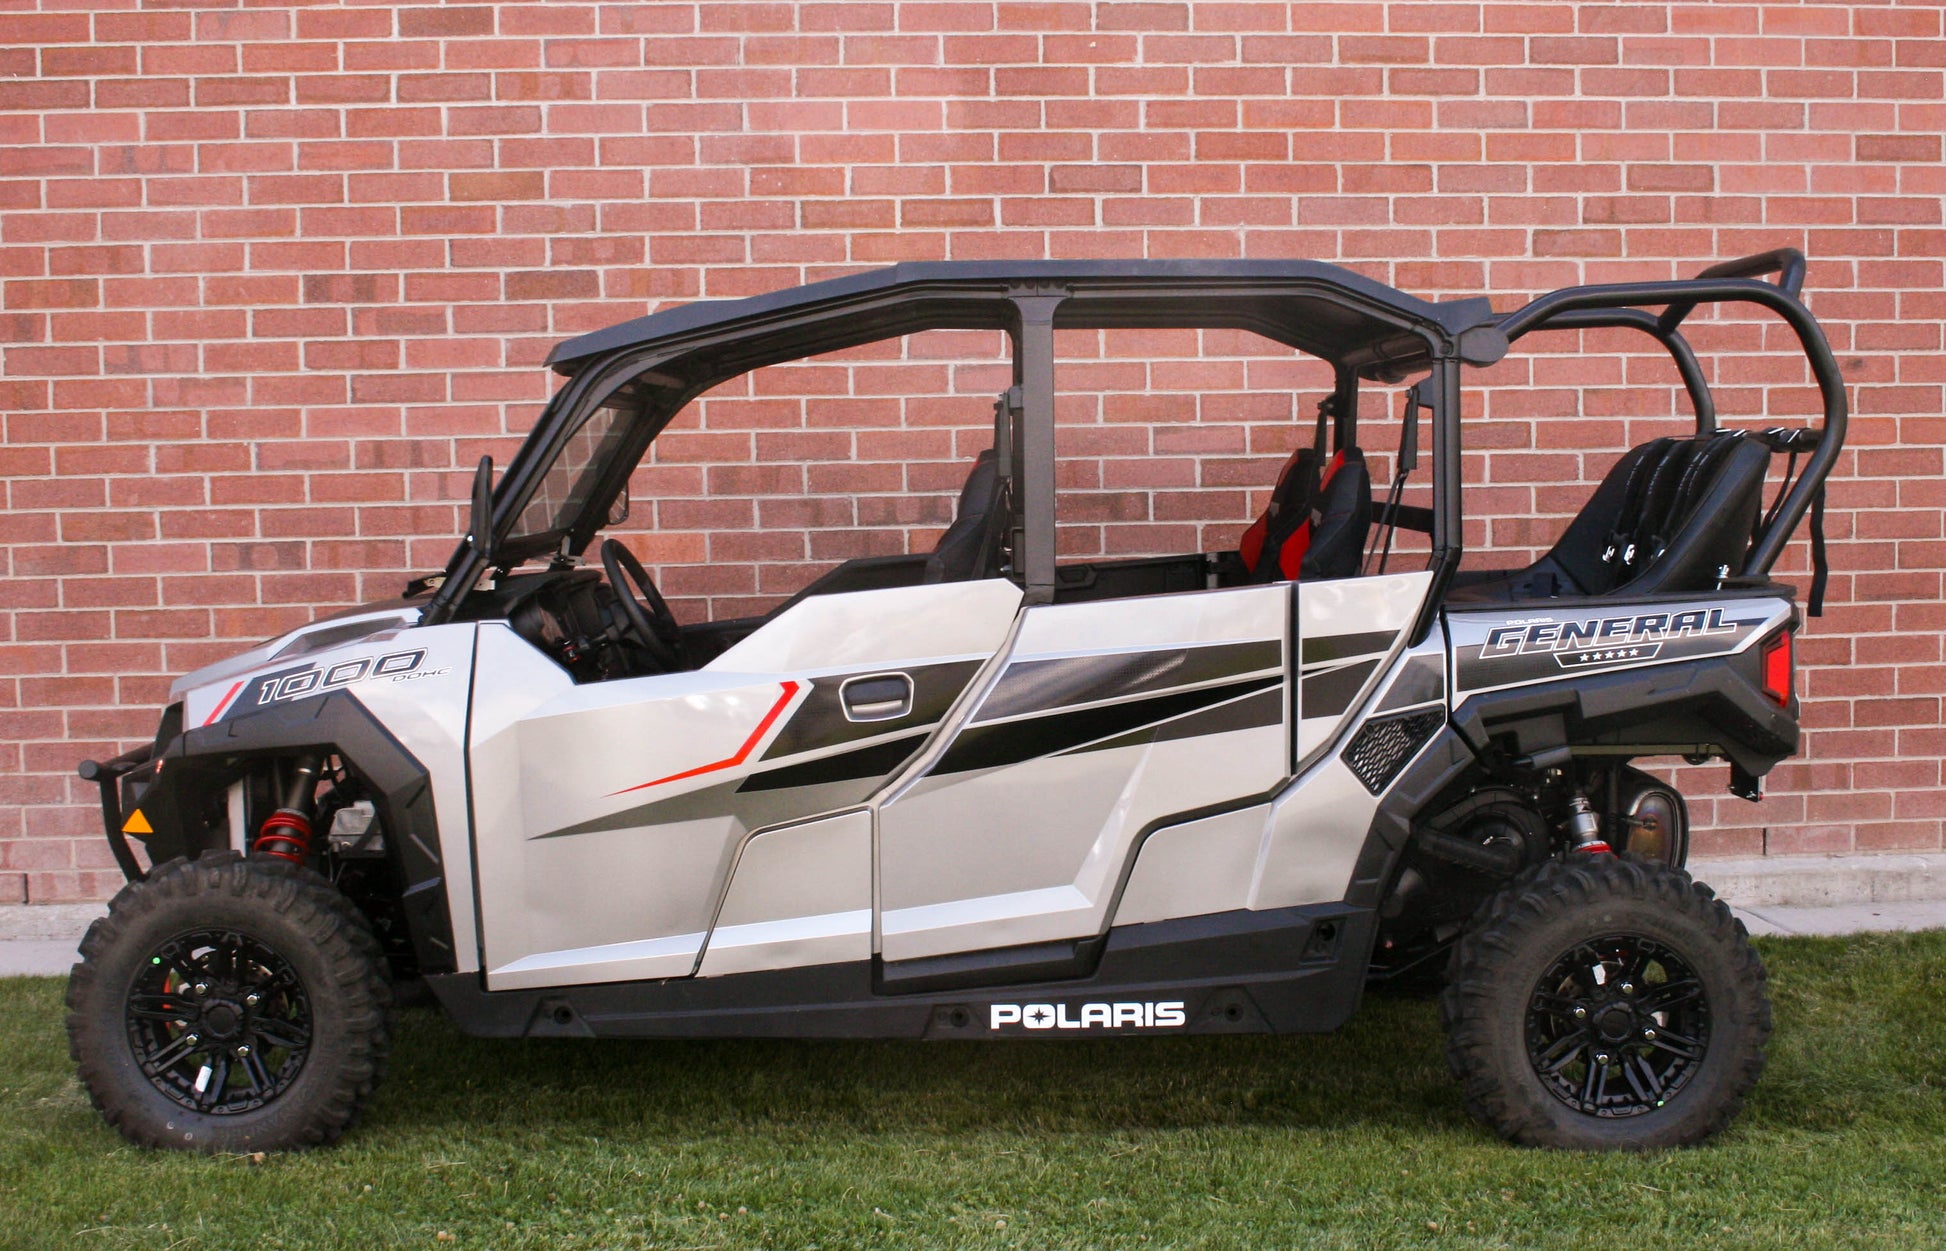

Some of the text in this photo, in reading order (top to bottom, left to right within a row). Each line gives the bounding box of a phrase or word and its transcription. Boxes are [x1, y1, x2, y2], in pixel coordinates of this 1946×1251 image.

[1479, 608, 1738, 659] GENERAL
[258, 647, 428, 705] 1000
[392, 666, 453, 682] DOHC
[991, 1002, 1185, 1029] POLARIS
